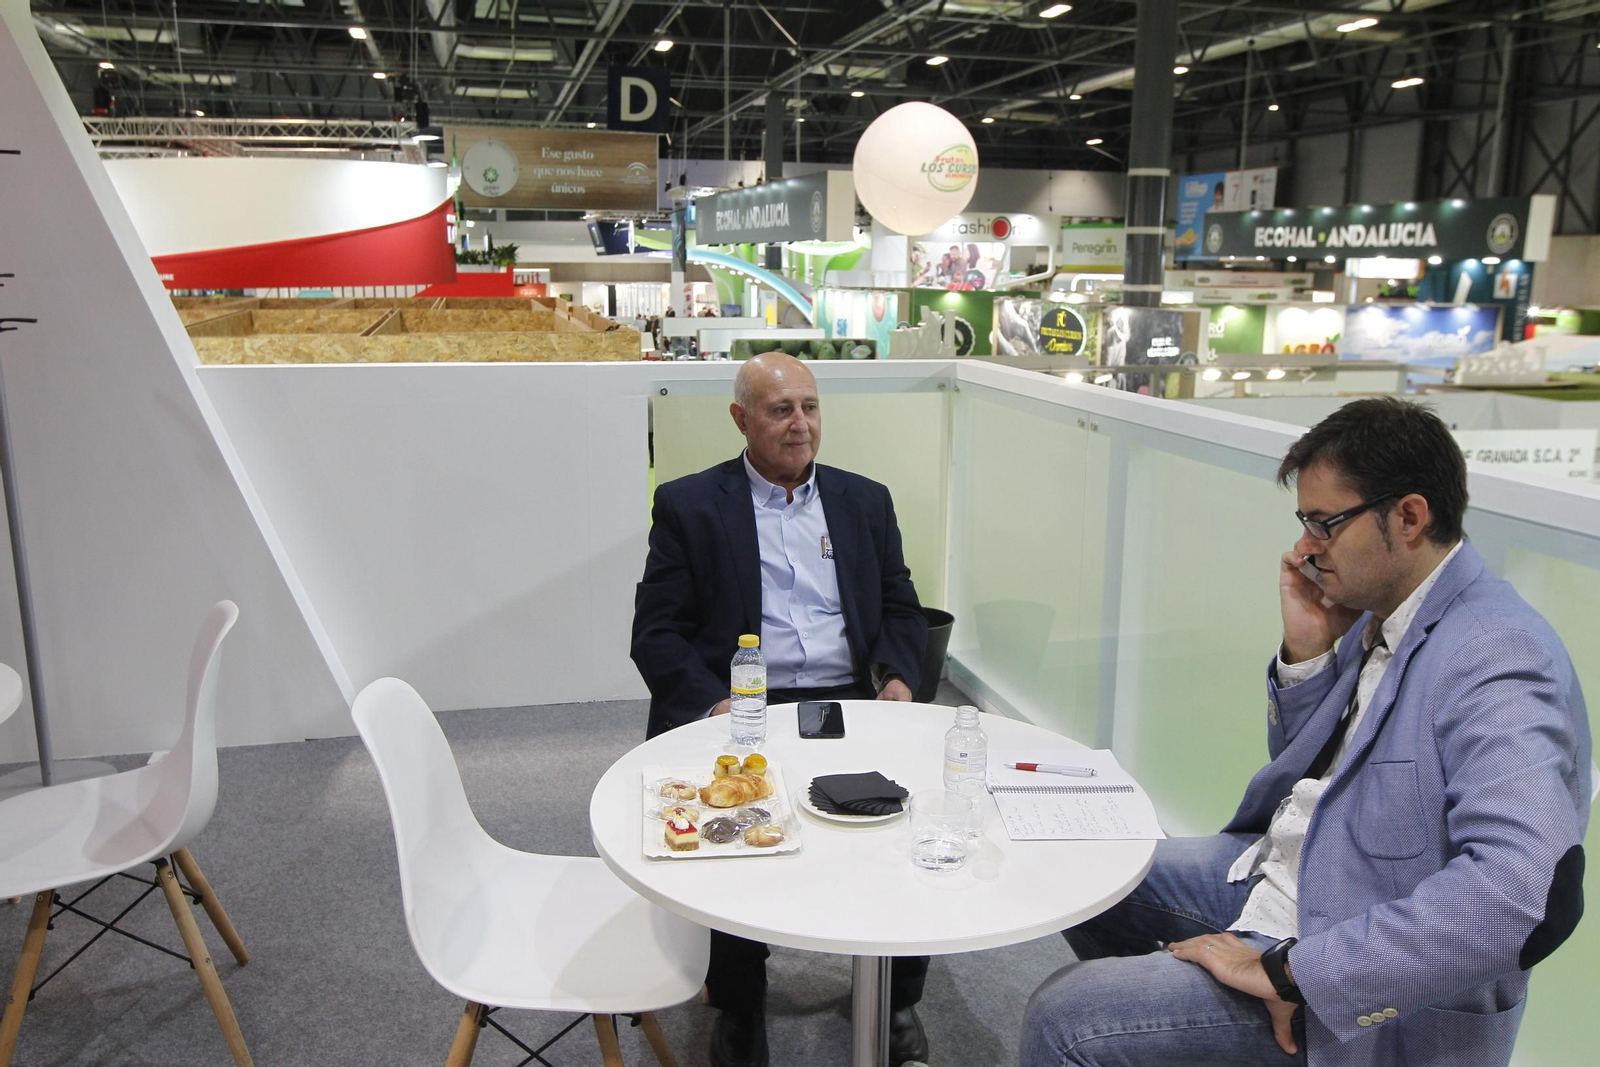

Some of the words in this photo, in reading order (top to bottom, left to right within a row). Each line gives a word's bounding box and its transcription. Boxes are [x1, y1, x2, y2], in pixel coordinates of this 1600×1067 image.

[620, 76, 657, 121] D
[541, 147, 561, 158] Ese
[563, 149, 594, 161] gusto
[533, 166, 554, 178] que
[556, 167, 574, 176] nos
[576, 165, 603, 177] hace
[920, 162, 945, 173] LOS
[551, 182, 586, 194] únicos
[1254, 225, 1317, 248] ECOHAL
